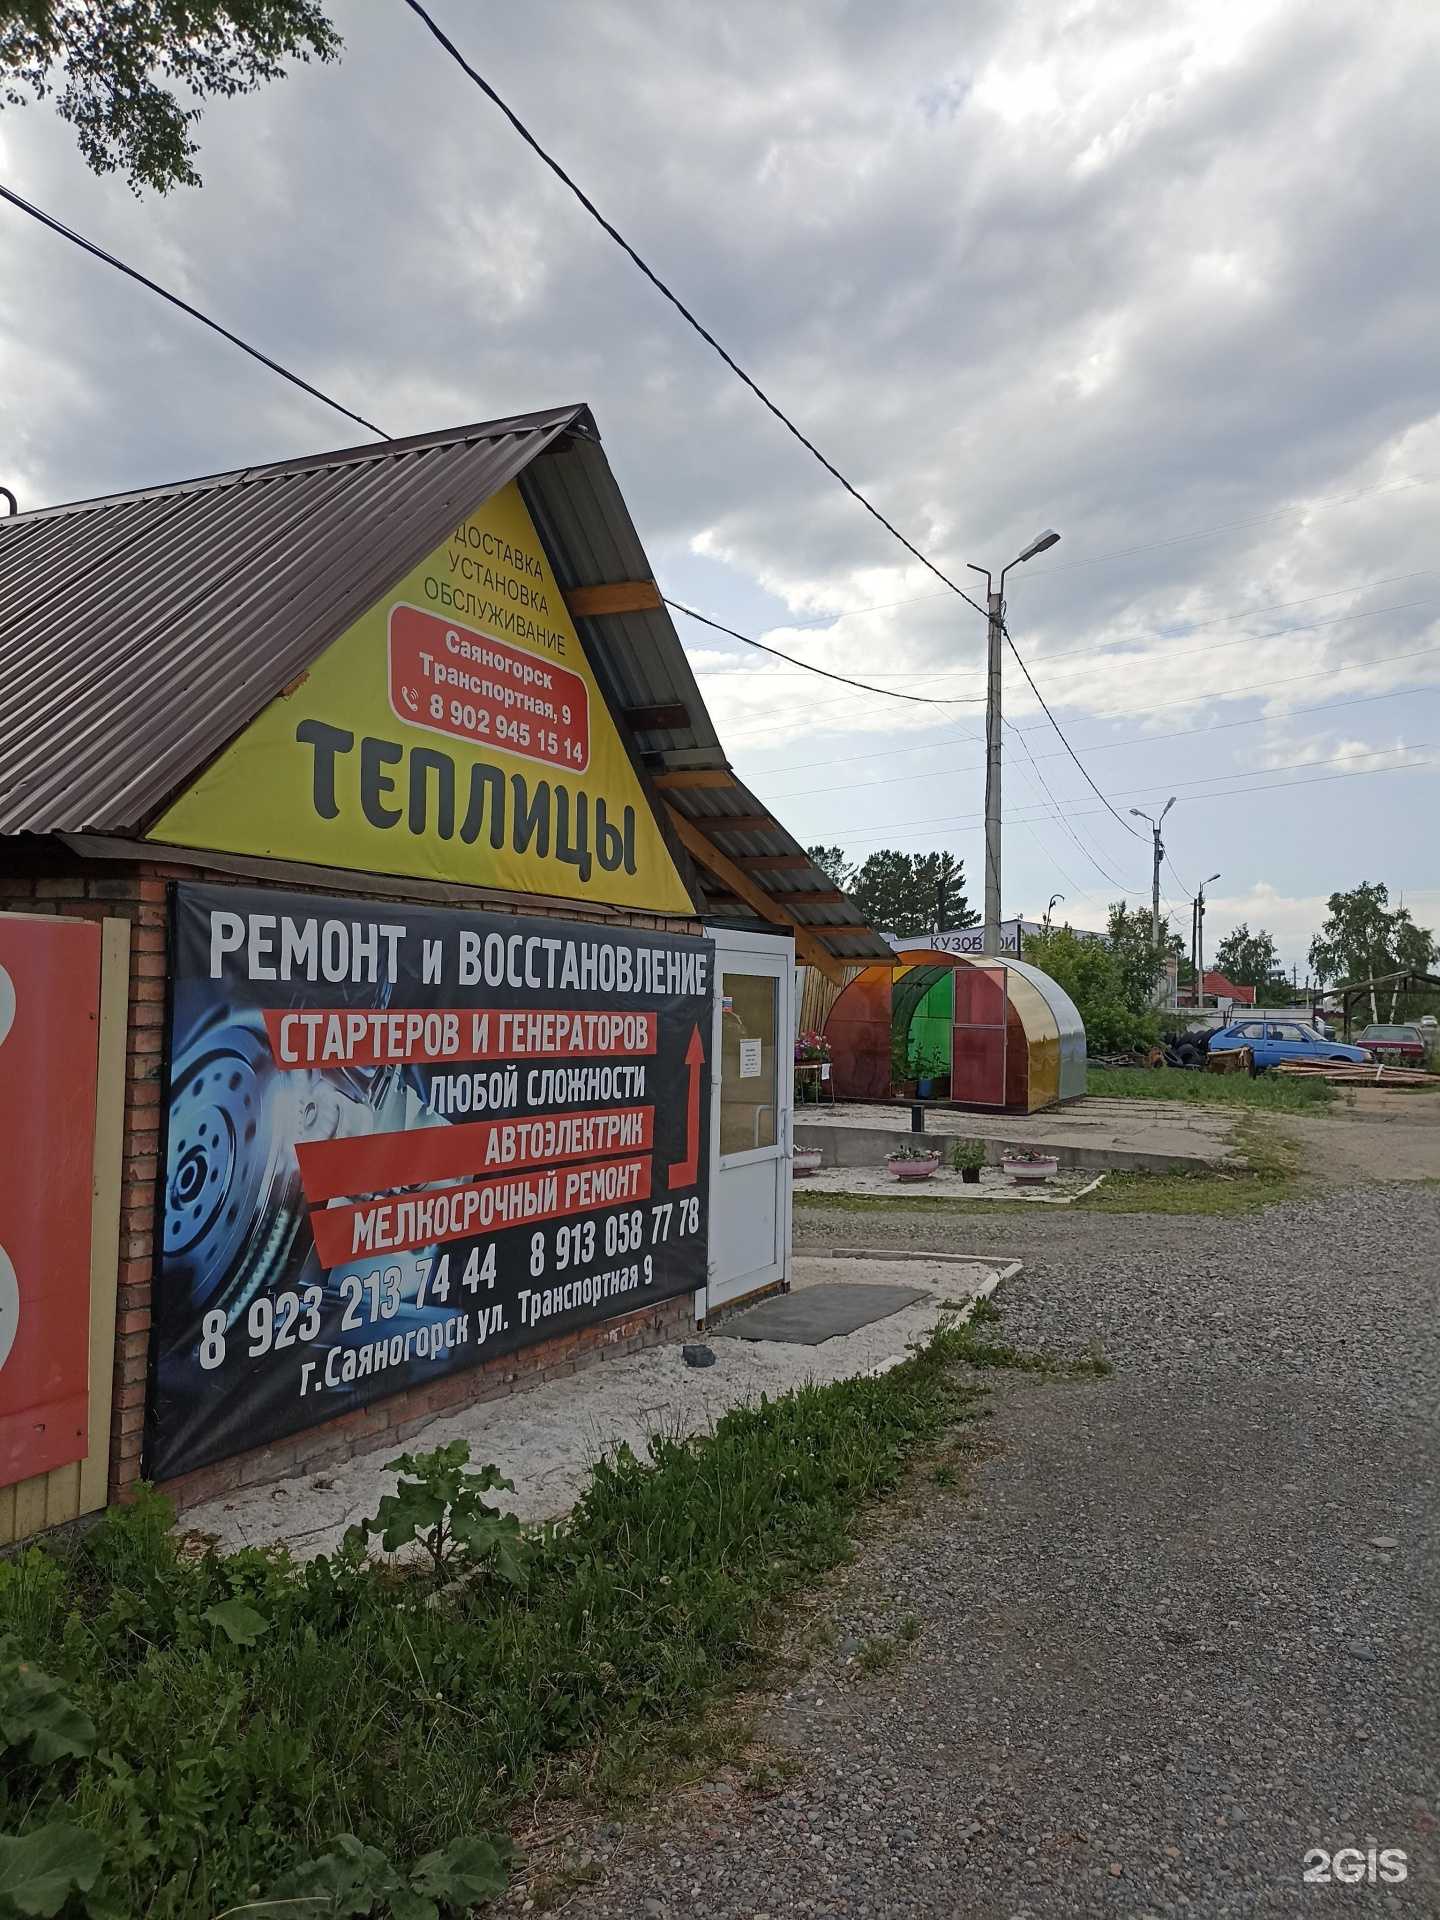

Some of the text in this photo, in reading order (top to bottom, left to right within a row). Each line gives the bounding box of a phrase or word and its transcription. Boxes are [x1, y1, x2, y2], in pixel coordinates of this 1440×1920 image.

[449, 551, 549, 616] УСТАНОВКА
[454, 522, 544, 581] ДОСТАВКА
[424, 576, 566, 656] ОБСЛУЖИВАНИЕ
[419, 651, 571, 725] Транспортная, 9
[445, 630, 553, 690] Саяногорск
[430, 694, 583, 763] 8 902 945 15 14
[296, 718, 637, 882] ТЕПЛИЦЫ
[210, 910, 407, 984] РЕМОНТ
[458, 931, 708, 996] ВОССТАНОВЛЕНИЕ
[930, 934, 1016, 951] КУЗОВЙ
[279, 1013, 649, 1063] СТАРТЕРОВ И ГЕНЕРАТОРОВ
[426, 1064, 645, 1115] ЛЮБОЙ СЛОЖНОСТИ
[484, 1112, 644, 1166] АВТОЭЛЕКТРИК
[351, 1162, 642, 1254] МЕЛКОСРОЧНЫЙ РЕМОНТ
[199, 1196, 699, 1370] 8 923 213 74 44 8 913 058 77 78
[299, 1254, 653, 1396] г.Саяногорск ул. Транспортная 9
